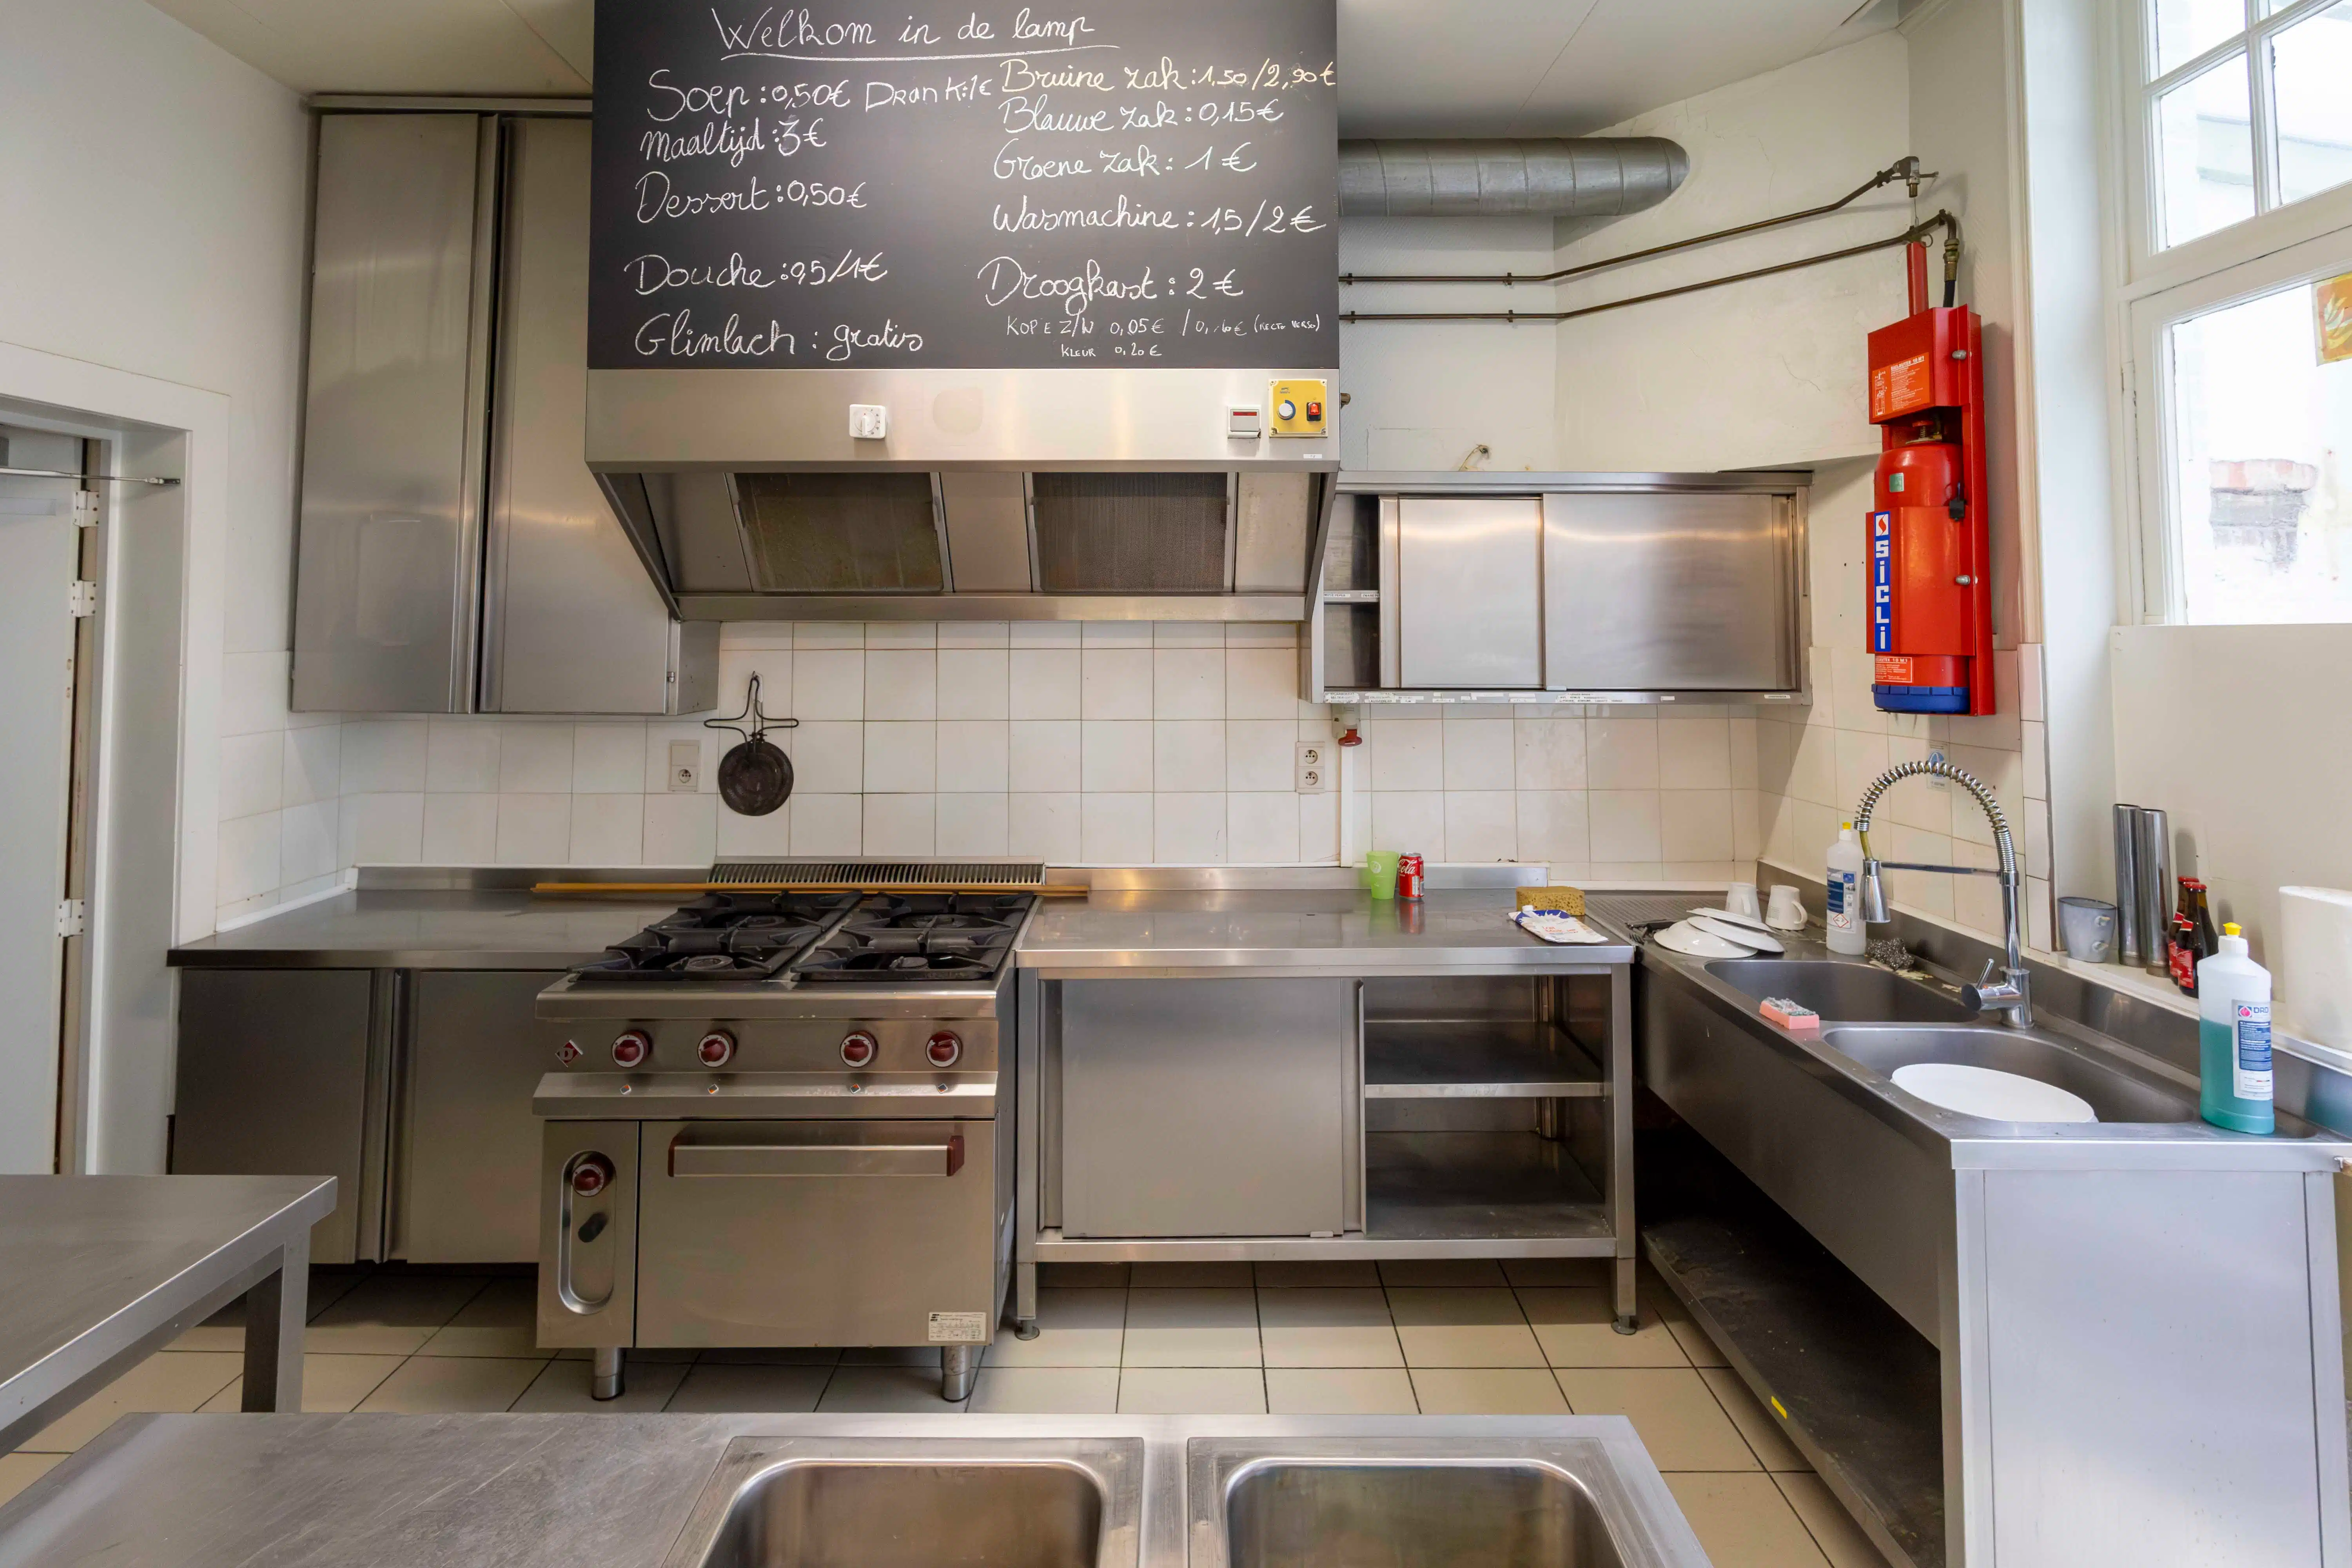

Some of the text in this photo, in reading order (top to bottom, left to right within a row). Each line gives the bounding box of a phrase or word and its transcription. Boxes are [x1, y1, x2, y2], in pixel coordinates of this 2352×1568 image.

[711, 7, 1095, 50] Welkom in de lamp
[647, 69, 750, 122] Soep
[1000, 58, 1115, 92] Bruine
[1124, 56, 1187, 90] zak
[998, 94, 1114, 133] Blauwe
[1120, 100, 1178, 130] zak
[993, 138, 1092, 180] Groene
[635, 171, 769, 223] Dessert
[993, 194, 1179, 232] Wasmachine
[624, 252, 776, 295] Douche
[977, 256, 1158, 316] Droogkast
[635, 309, 795, 356] Glimlach
[826, 318, 923, 361] gratis
[1061, 343, 1096, 357] KLEUR
